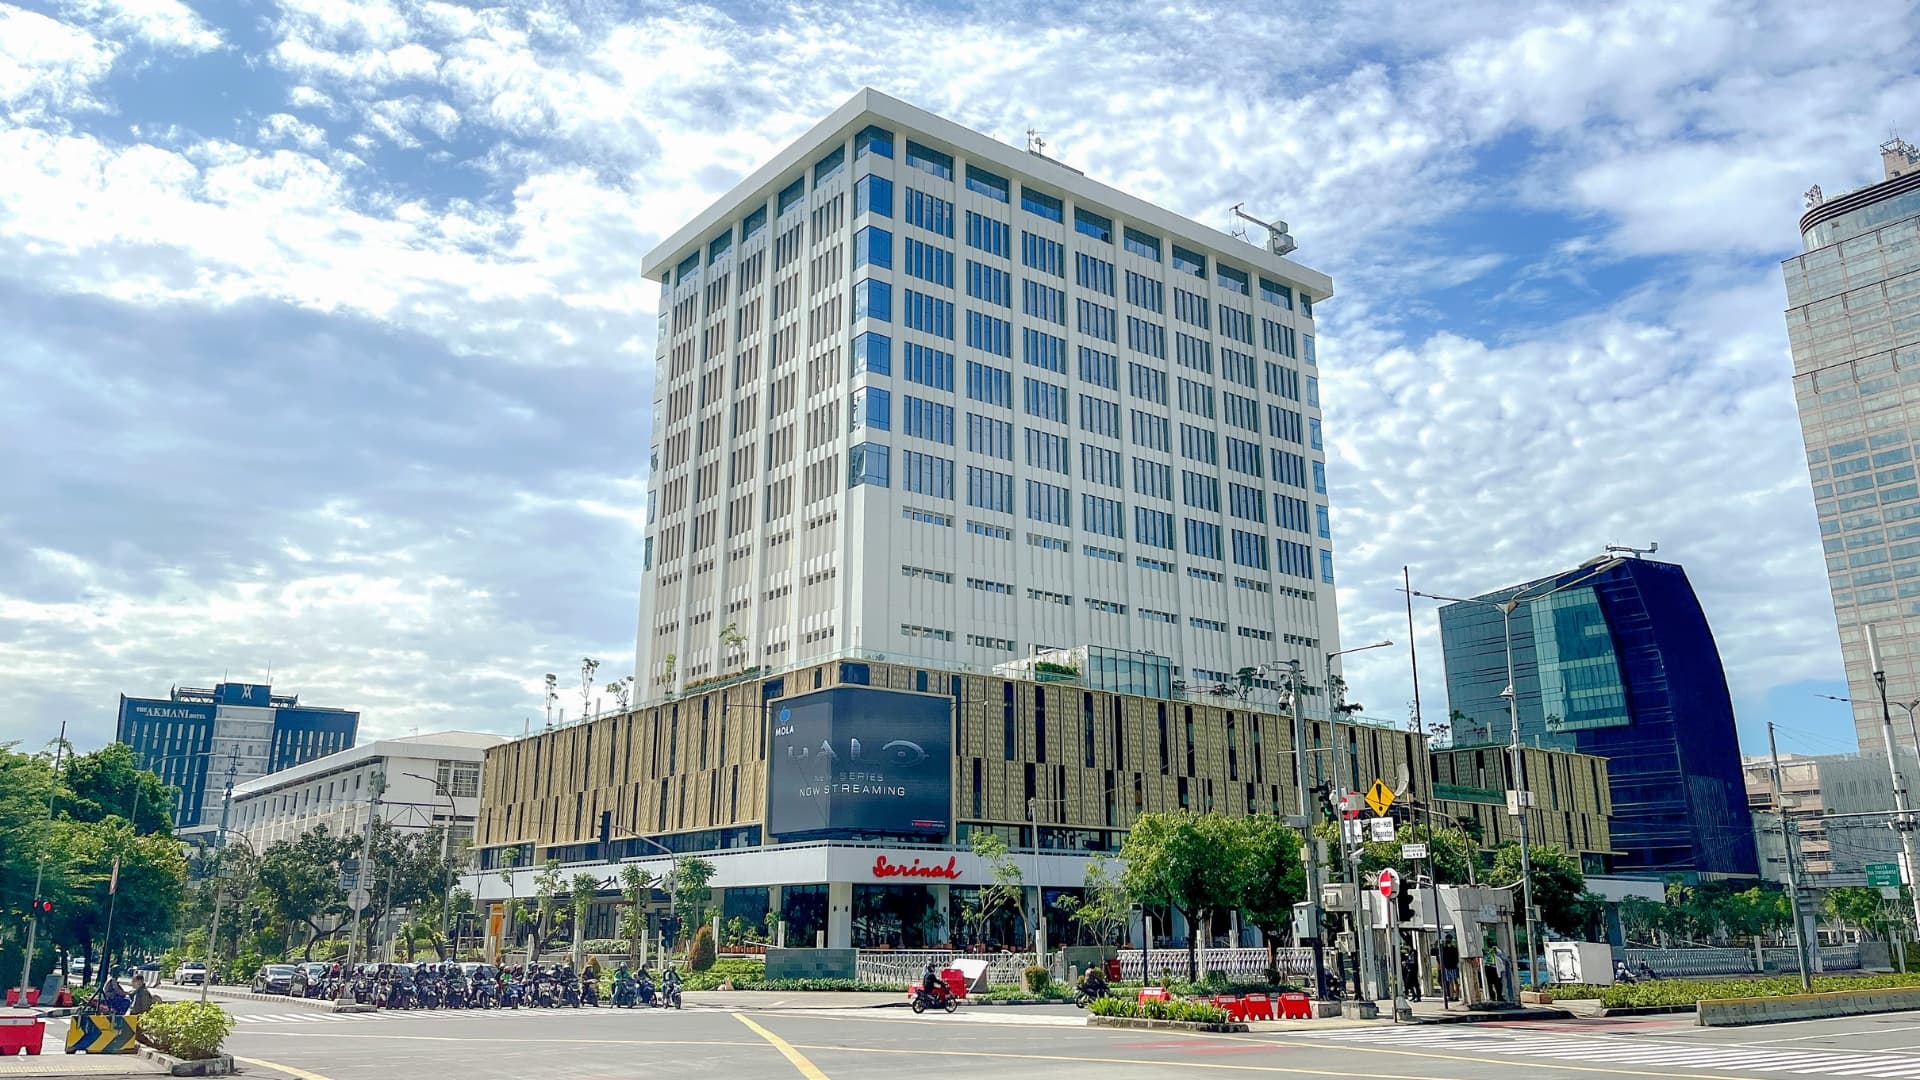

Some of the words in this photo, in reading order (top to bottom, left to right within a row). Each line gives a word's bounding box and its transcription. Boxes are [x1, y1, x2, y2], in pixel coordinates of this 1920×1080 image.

[145, 707, 189, 719] AKMANI
[775, 725, 794, 737] MOLA
[839, 772, 884, 783] SERIES
[799, 786, 820, 798] NOW
[824, 783, 905, 797] STREAMING
[872, 855, 963, 879] Sarinah
